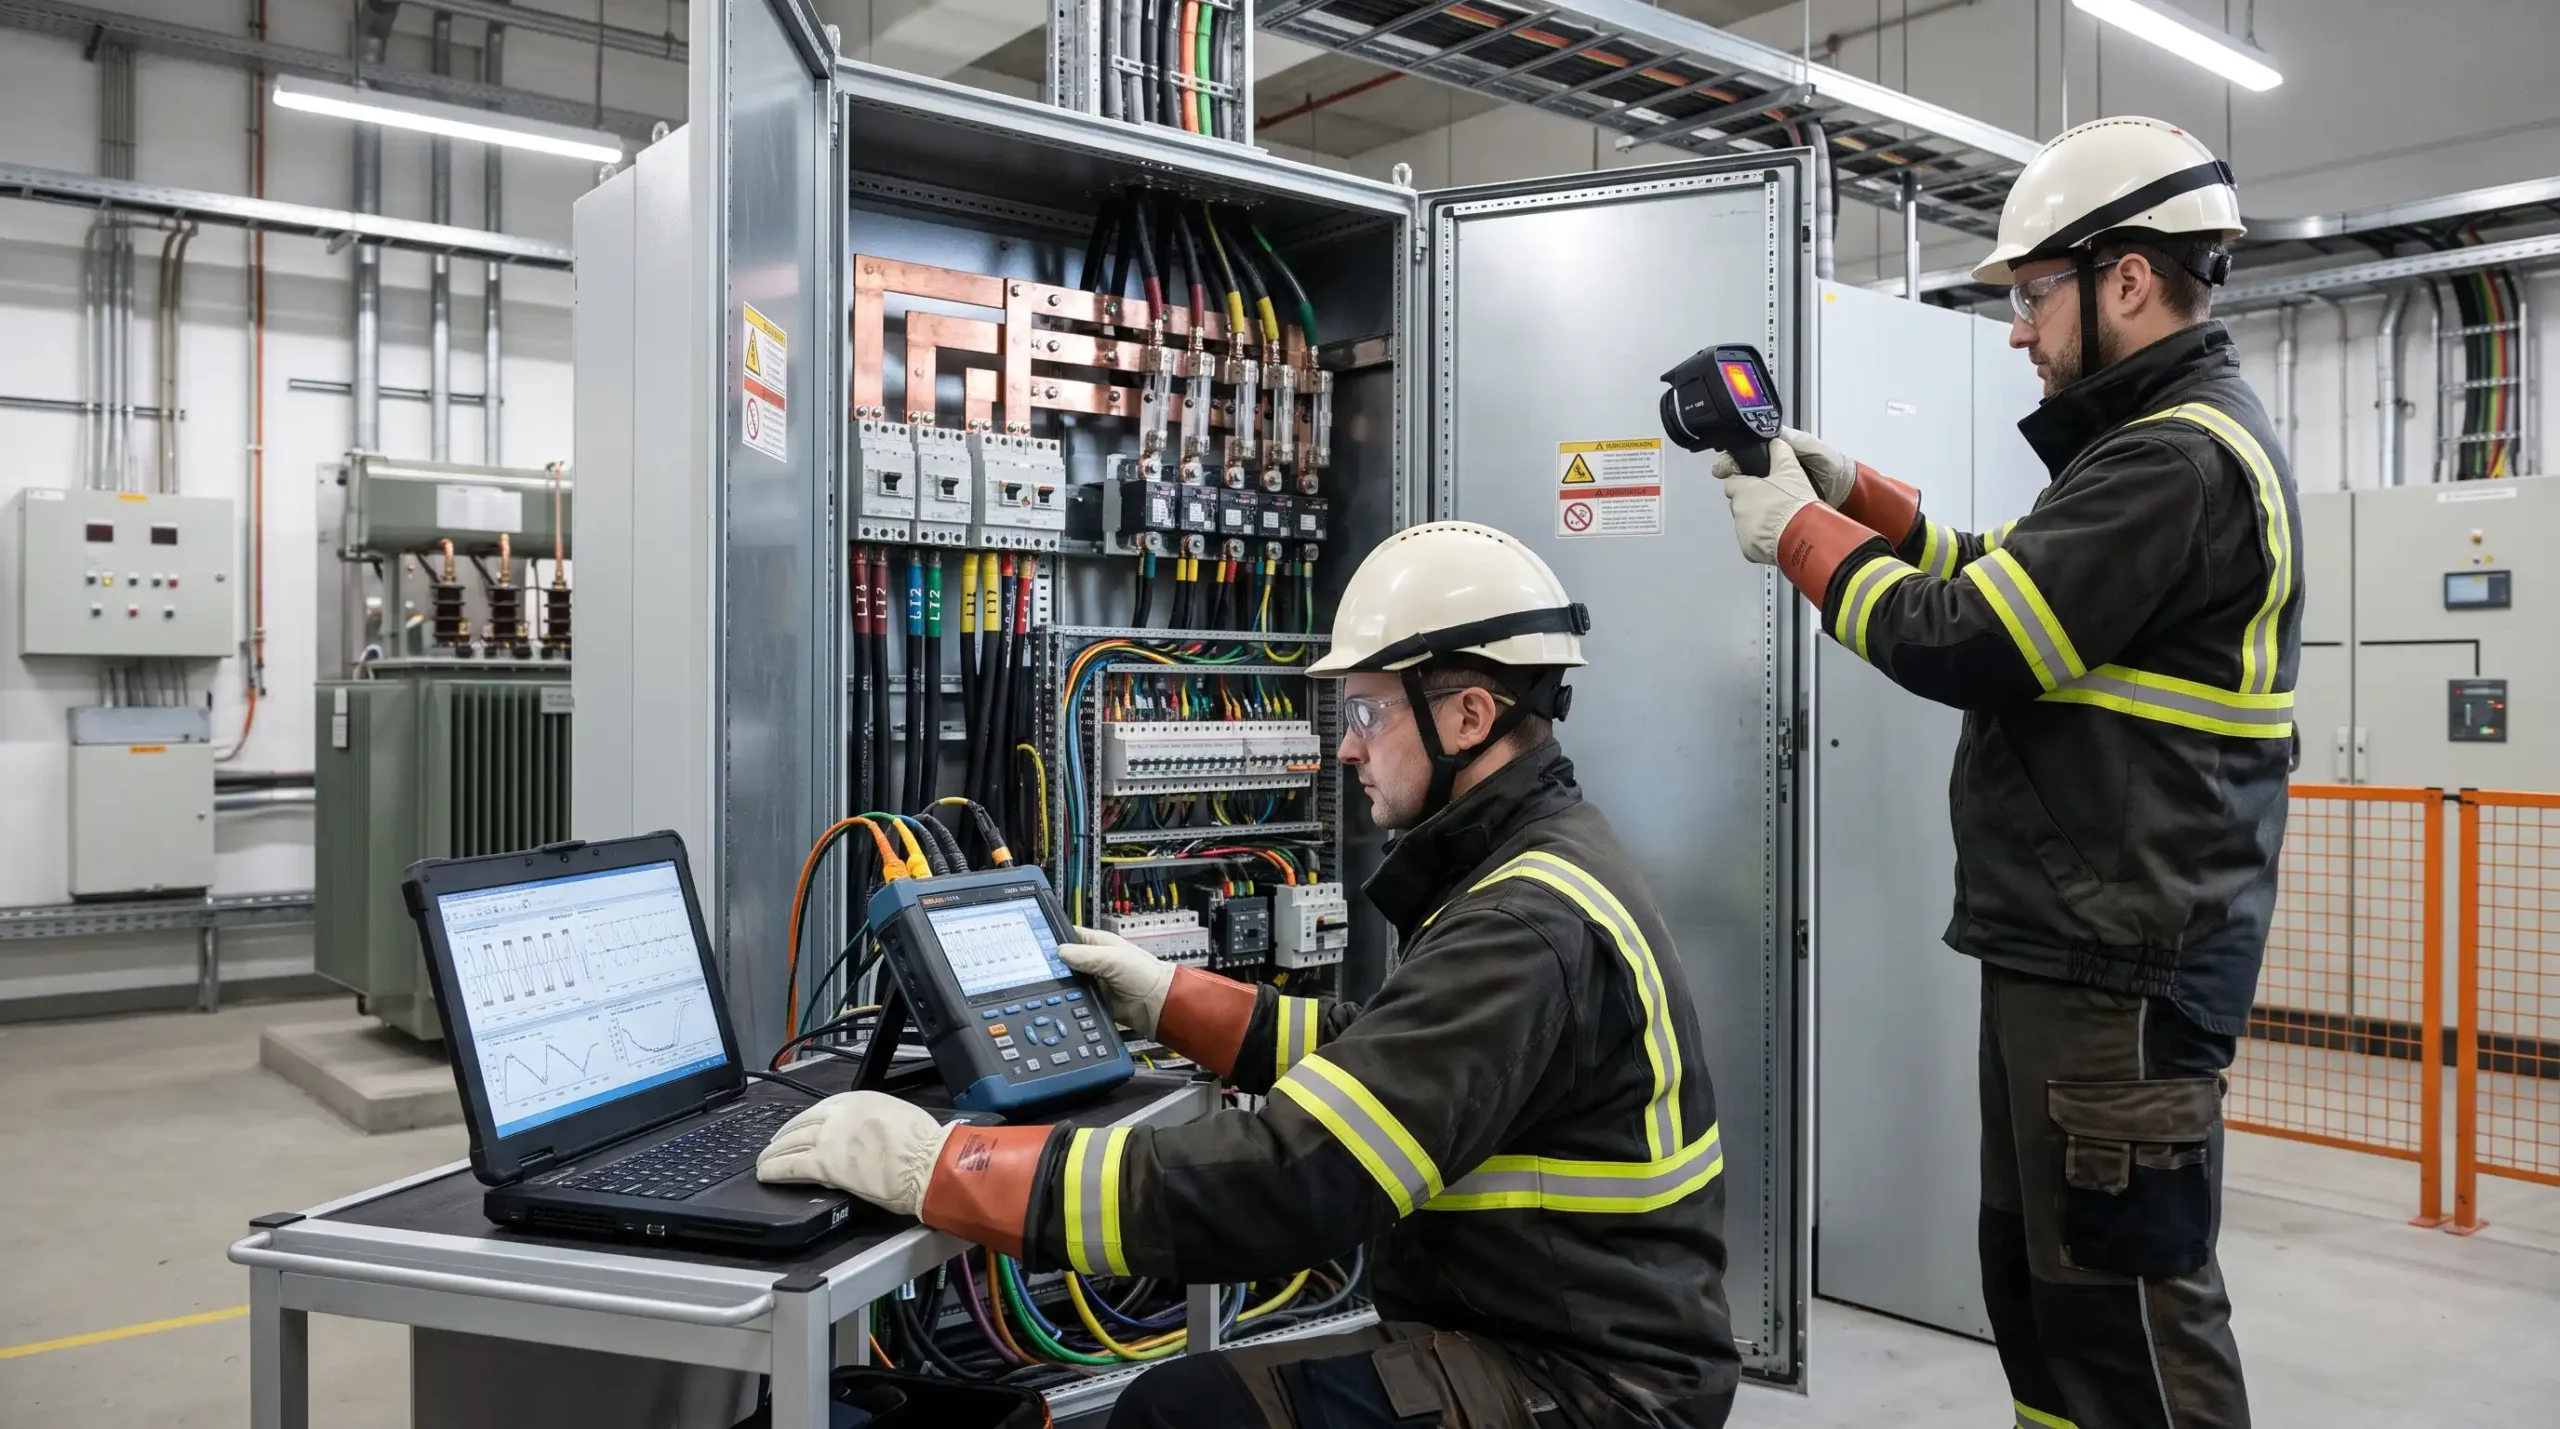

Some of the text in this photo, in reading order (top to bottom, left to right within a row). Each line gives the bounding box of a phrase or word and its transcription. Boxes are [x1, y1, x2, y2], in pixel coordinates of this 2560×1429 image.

[875, 587, 887, 619] LT2
[909, 588, 922, 620] LT2
[929, 589, 941, 621] LT2
